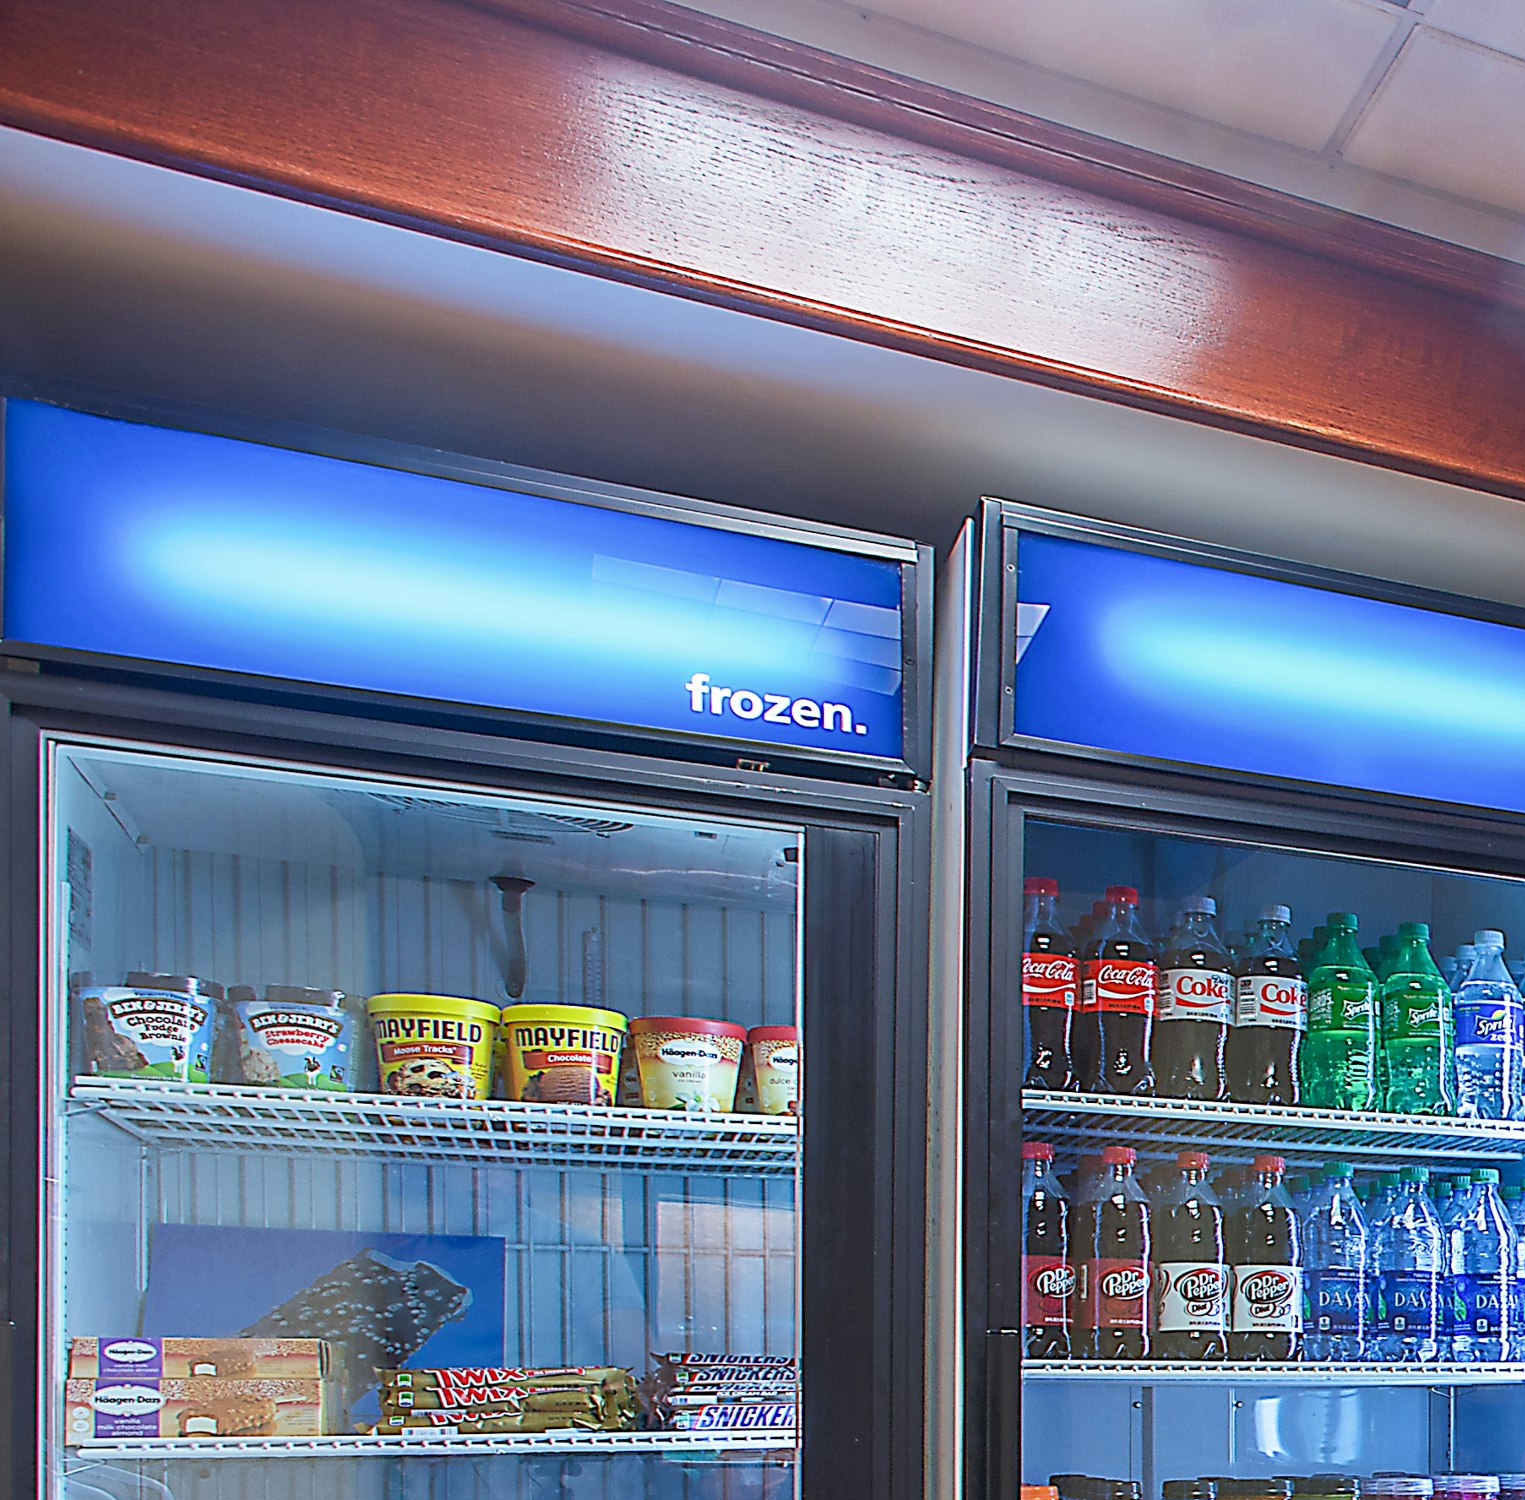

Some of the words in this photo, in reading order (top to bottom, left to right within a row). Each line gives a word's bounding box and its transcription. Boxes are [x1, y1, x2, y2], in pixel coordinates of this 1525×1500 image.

[684, 673, 867, 736] frozen.
[1098, 963, 1153, 988] Coca-Cola
[1176, 975, 1228, 999] Coke
[1260, 983, 1307, 1007] Coke
[265, 1029, 329, 1044] Strawberry
[376, 1018, 482, 1043] MAYFIELD
[515, 1027, 619, 1053] MAYFIELD
[266, 1037, 325, 1049] Cheesecake
[547, 1053, 592, 1064] Chocolate
[1248, 1279, 1290, 1299] Pepper
[1262, 1275, 1280, 1287] Dr
